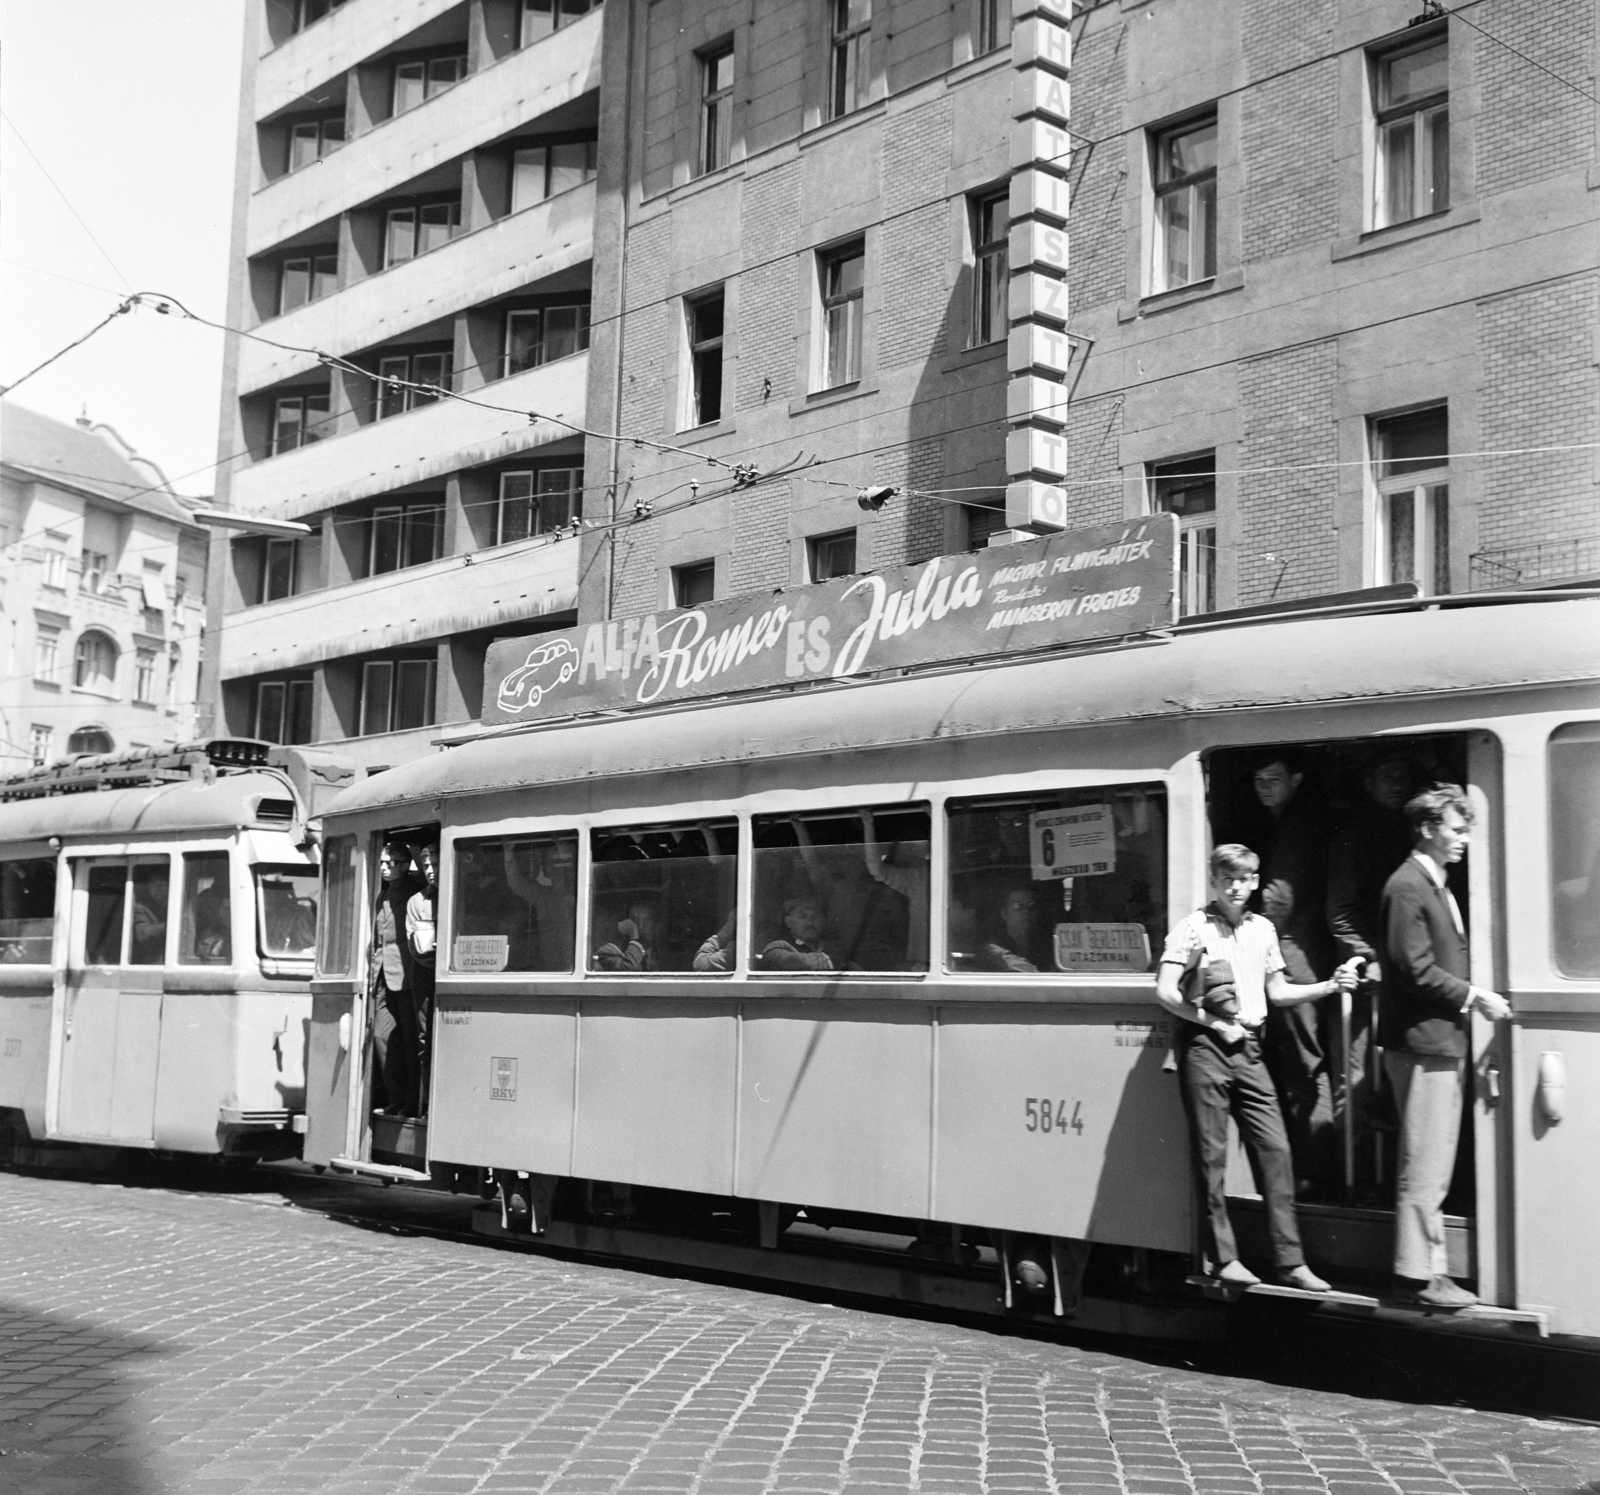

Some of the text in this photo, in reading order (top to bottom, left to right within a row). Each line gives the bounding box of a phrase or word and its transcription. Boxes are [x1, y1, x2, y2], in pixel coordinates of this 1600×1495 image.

[987, 560, 1048, 589] MAGYAR
[1075, 586, 1142, 616] FRIGYES
[577, 614, 661, 686] ALFA
[637, 605, 792, 703] Romeo
[1042, 828, 1055, 866] 6
[492, 1087, 516, 1099] BKV
[1025, 1097, 1084, 1136] 5844
